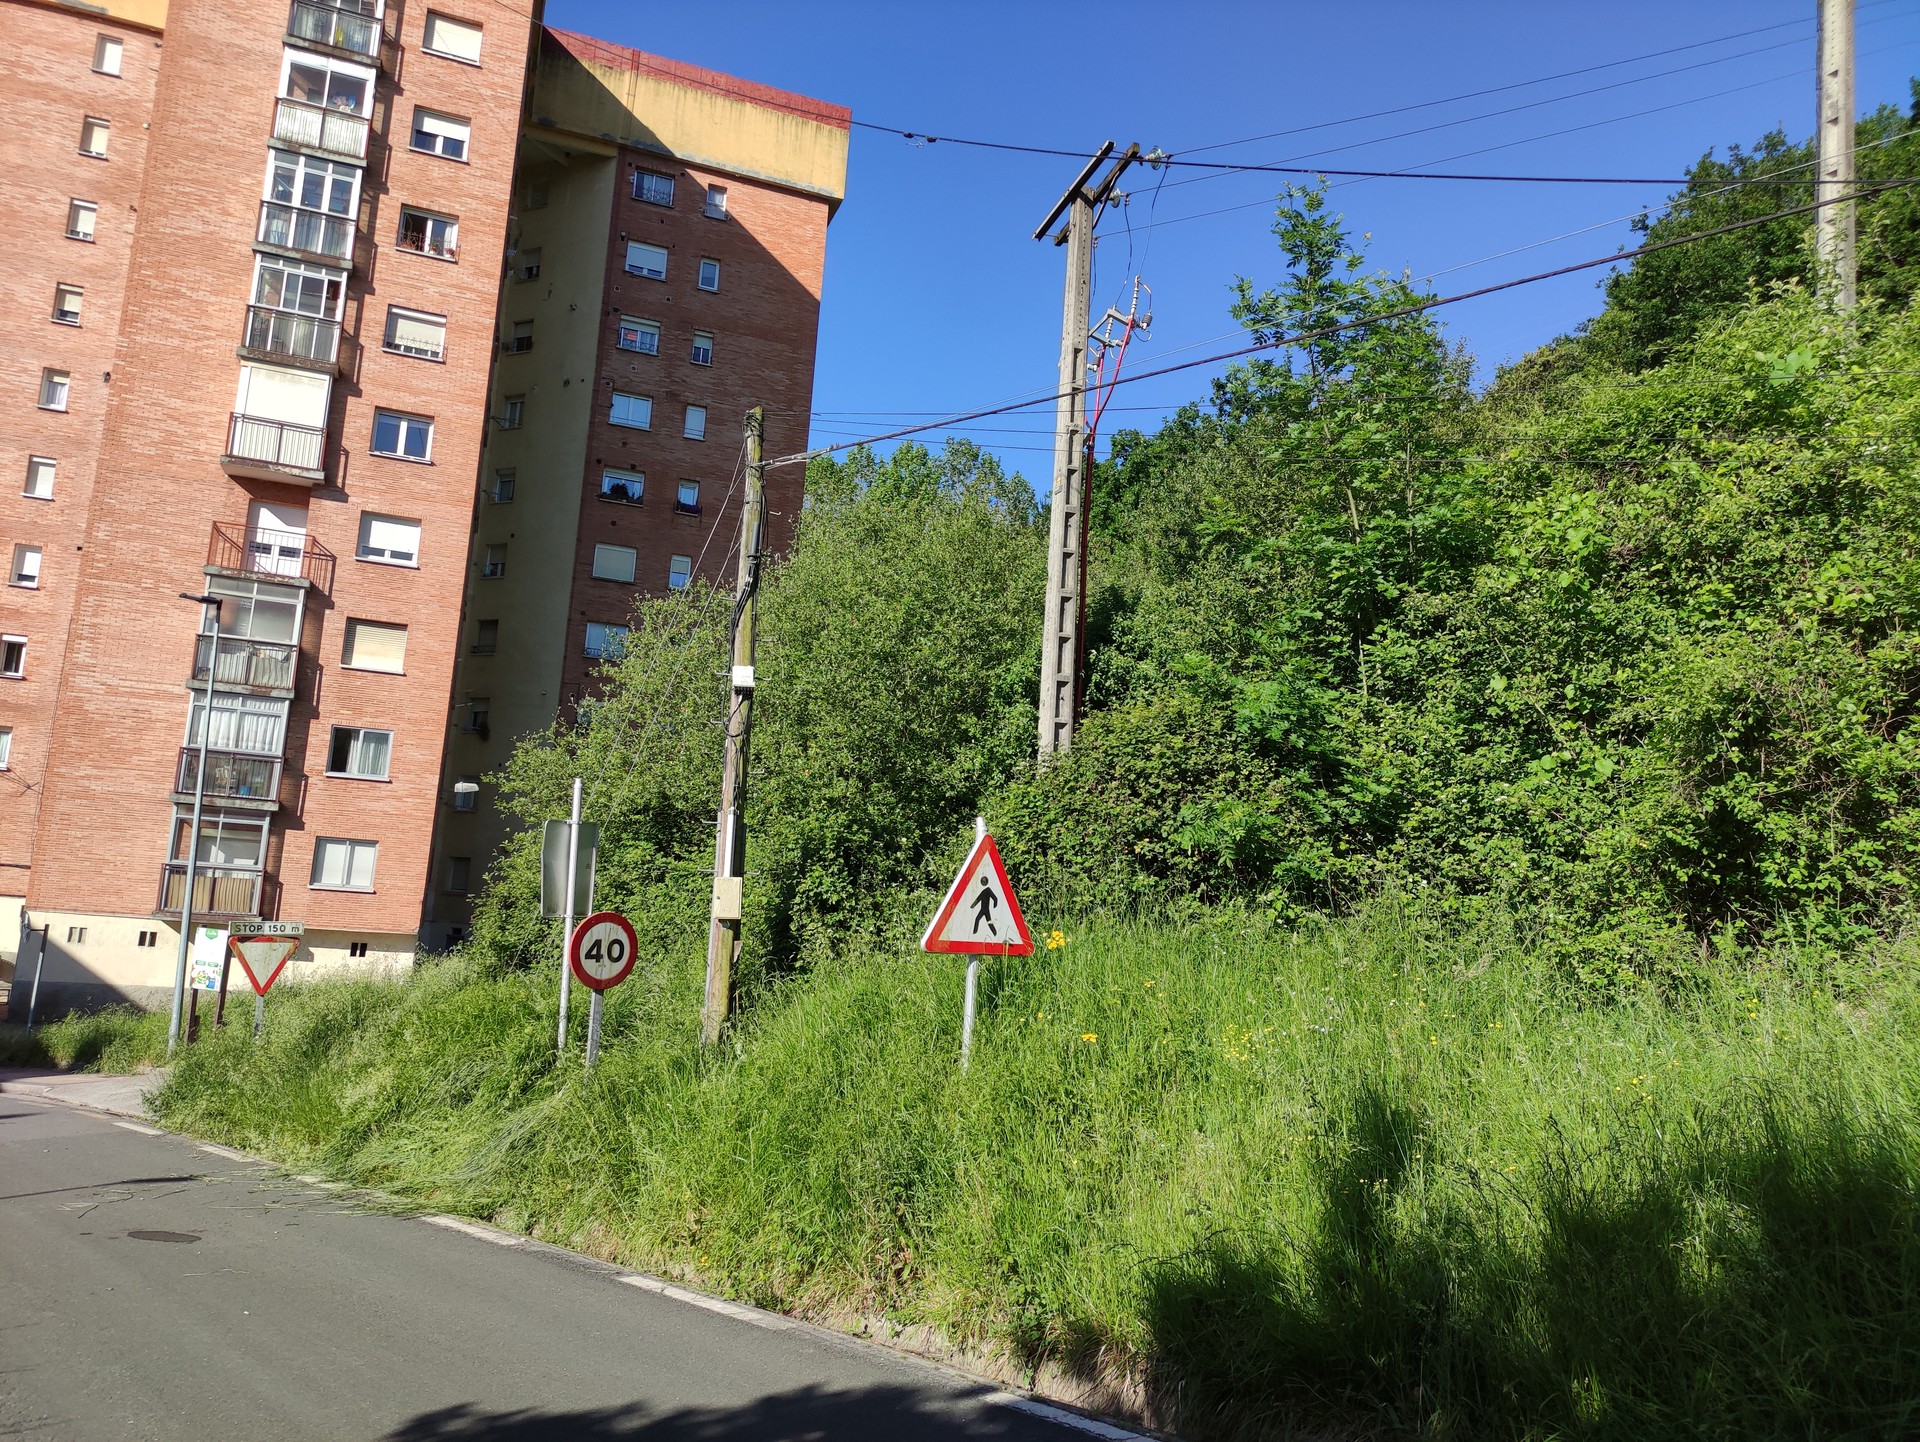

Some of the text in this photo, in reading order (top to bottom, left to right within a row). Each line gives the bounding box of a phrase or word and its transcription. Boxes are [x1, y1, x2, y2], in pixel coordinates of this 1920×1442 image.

[235, 924, 263, 933] STOP
[268, 924, 286, 933] 150
[584, 938, 625, 963] 40
